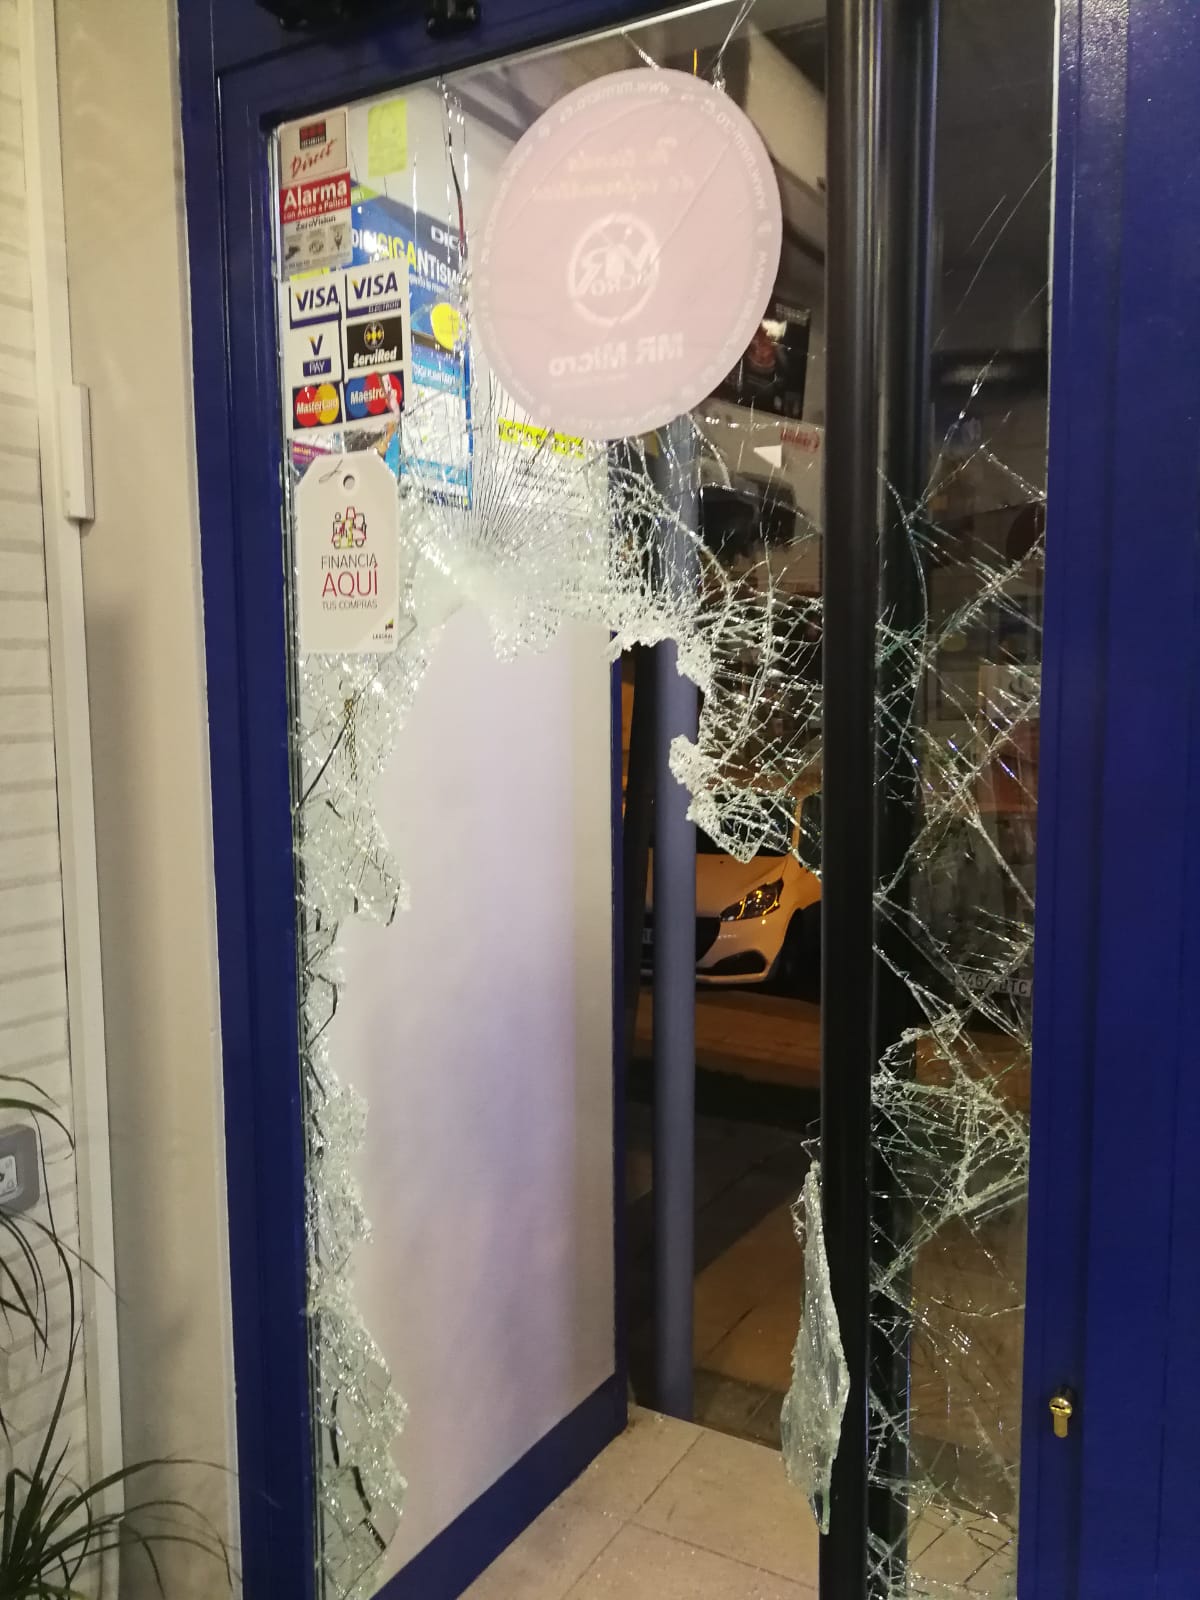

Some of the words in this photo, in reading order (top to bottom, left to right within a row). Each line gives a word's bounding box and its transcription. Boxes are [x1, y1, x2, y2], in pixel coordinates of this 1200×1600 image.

[290, 138, 337, 178] Direct
[283, 180, 347, 211] Alarma
[352, 271, 398, 299] VISA
[296, 284, 339, 312] VISA
[309, 333, 323, 356] V
[310, 359, 325, 374] PAY
[353, 346, 397, 367] ServiRed
[296, 396, 339, 415] MasterCard
[321, 552, 378, 569] FINANCIA
[322, 562, 378, 598] AQUÍ
[322, 600, 337, 611] TUS
[339, 599, 378, 610] COMPRAS
